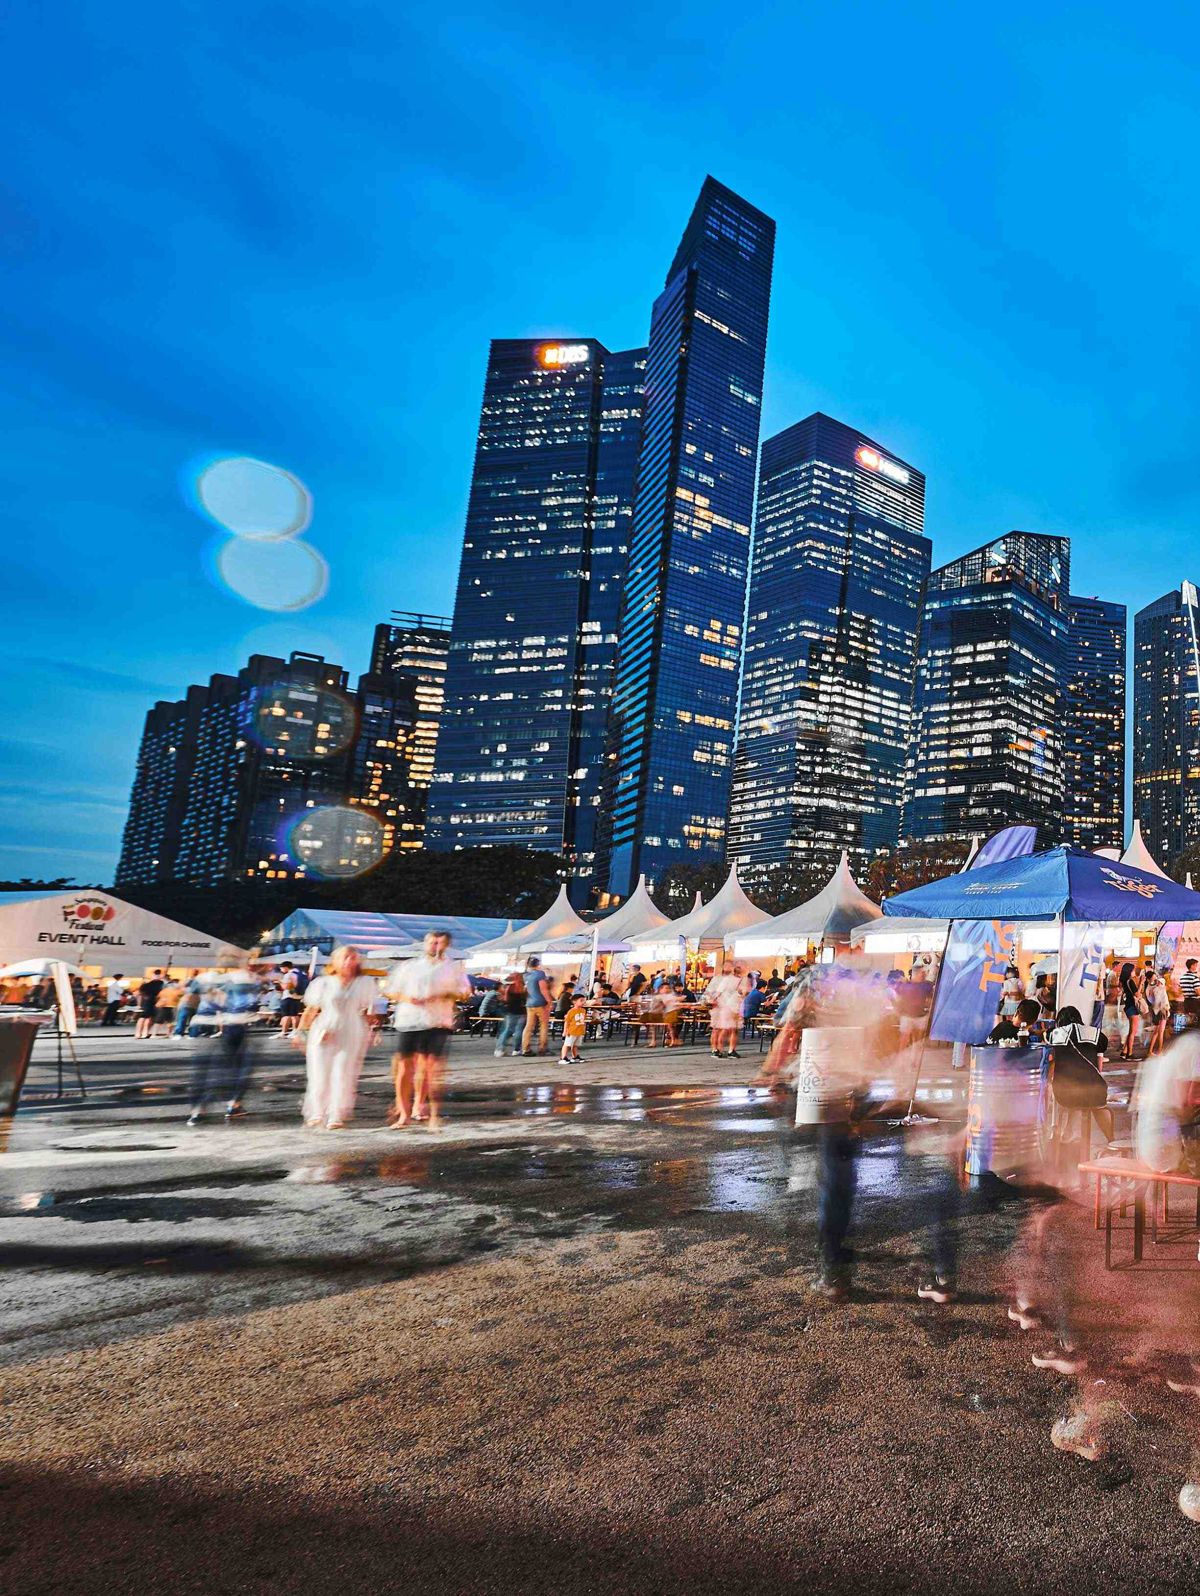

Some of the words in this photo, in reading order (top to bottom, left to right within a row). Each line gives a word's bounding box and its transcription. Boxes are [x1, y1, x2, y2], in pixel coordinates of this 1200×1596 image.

[1102, 878, 1165, 899] Tiger
[37, 932, 87, 944] EVENT
[90, 935, 126, 946] HALL
